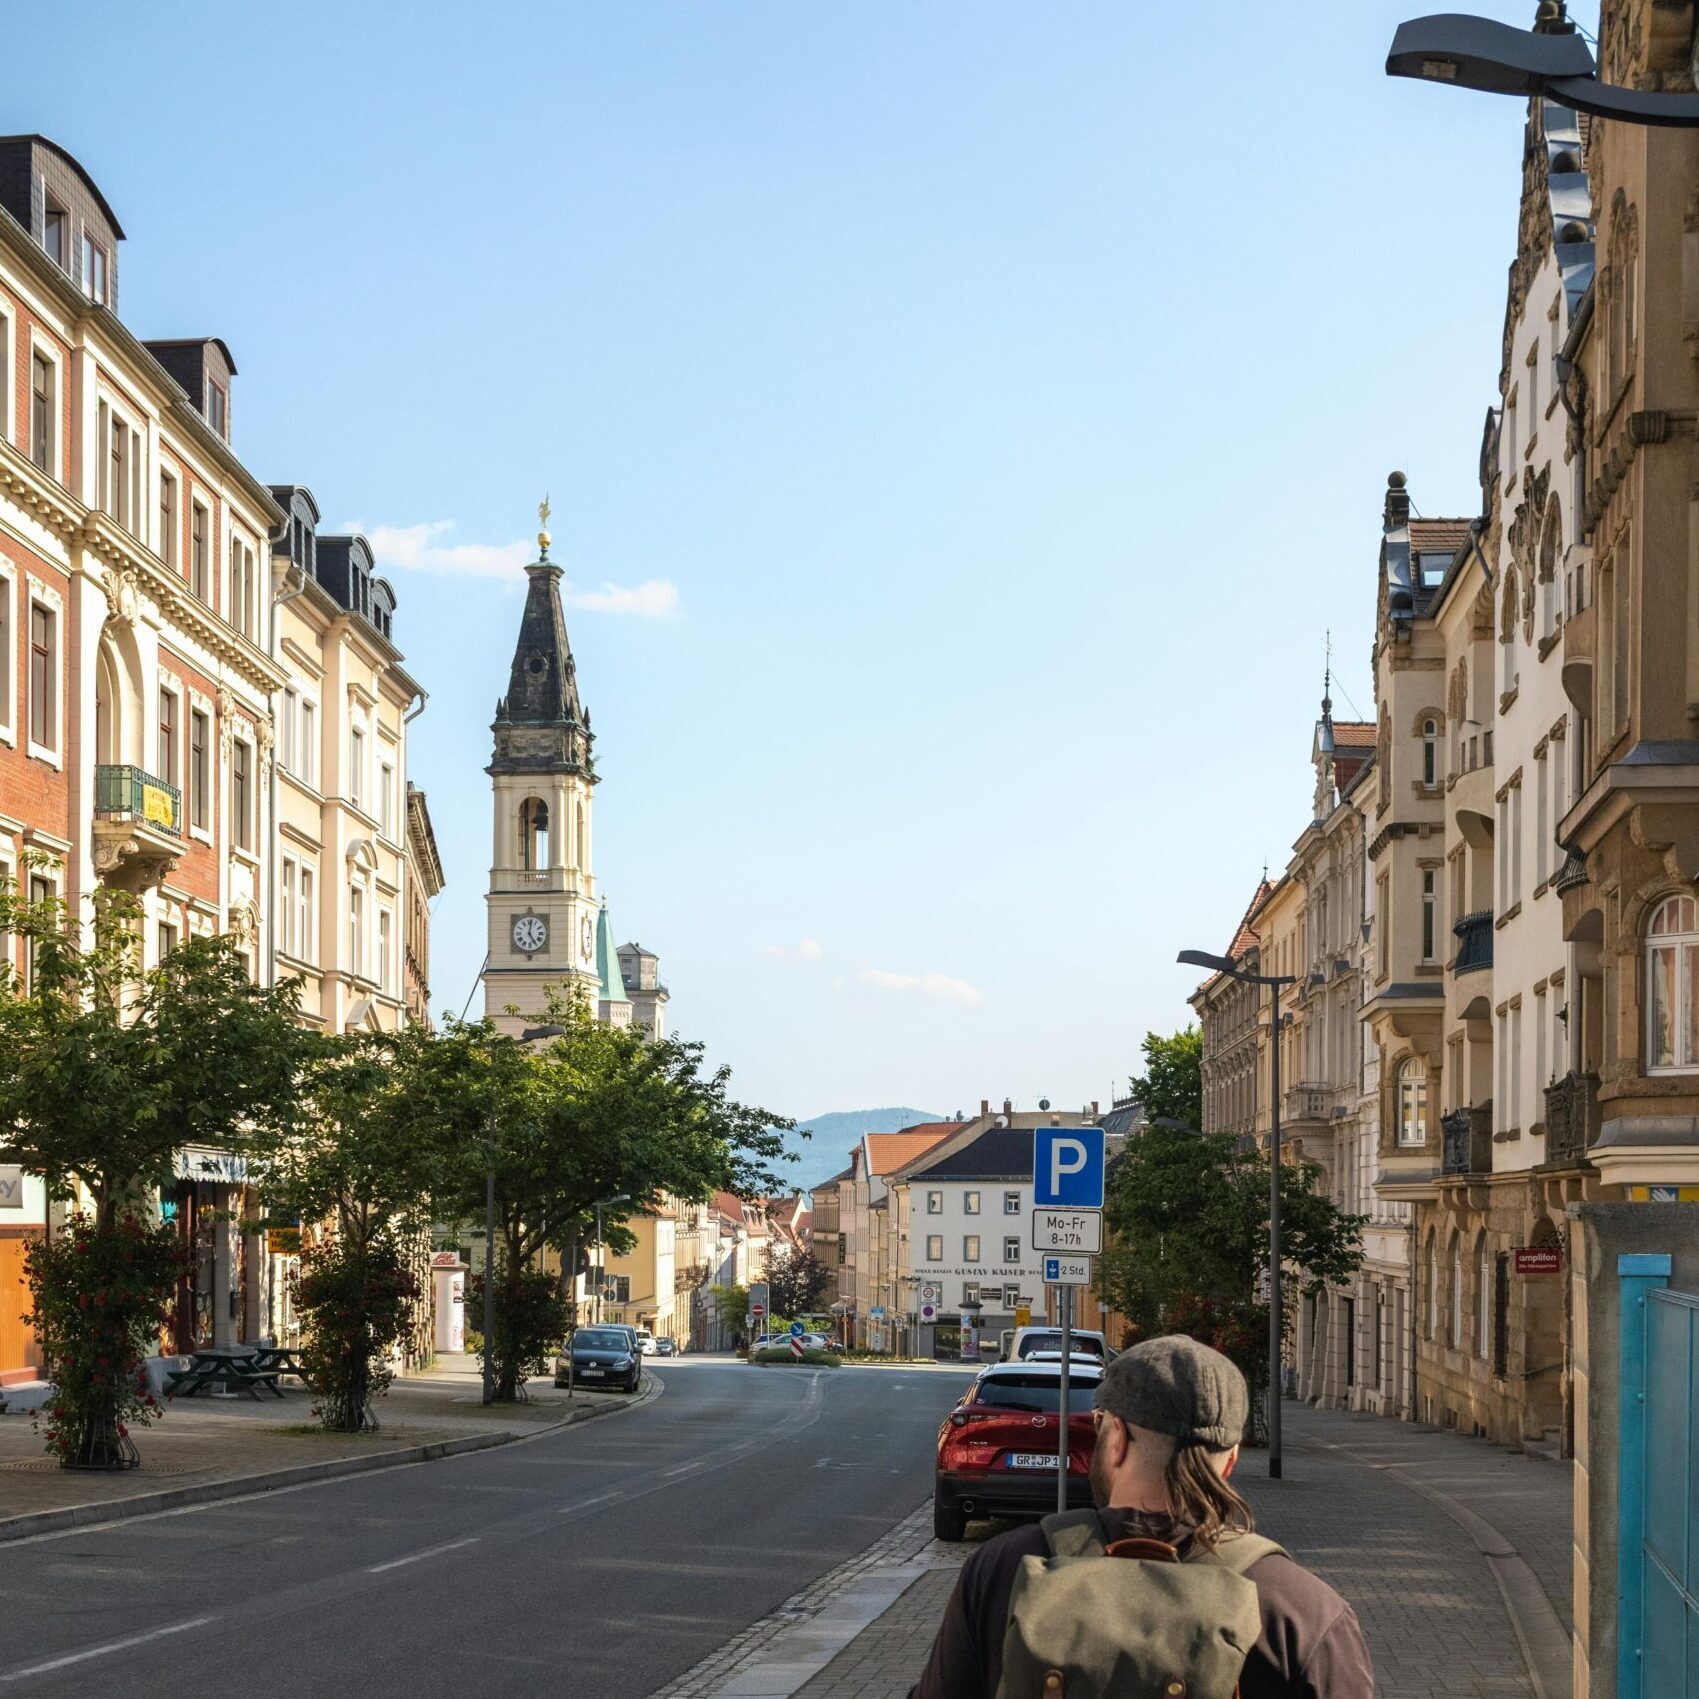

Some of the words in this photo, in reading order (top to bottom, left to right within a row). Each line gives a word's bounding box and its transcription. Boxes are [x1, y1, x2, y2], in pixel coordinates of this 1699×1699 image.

[1051, 1138, 1087, 1195] P
[1047, 1216, 1085, 1229] Mo-Fr
[1051, 1233, 1081, 1245] 8-17h
[1519, 1253, 1556, 1263] amplifon
[954, 1268, 988, 1276] GUSTAV
[992, 1268, 1026, 1277] KAISER
[1017, 1456, 1030, 1465] GR
